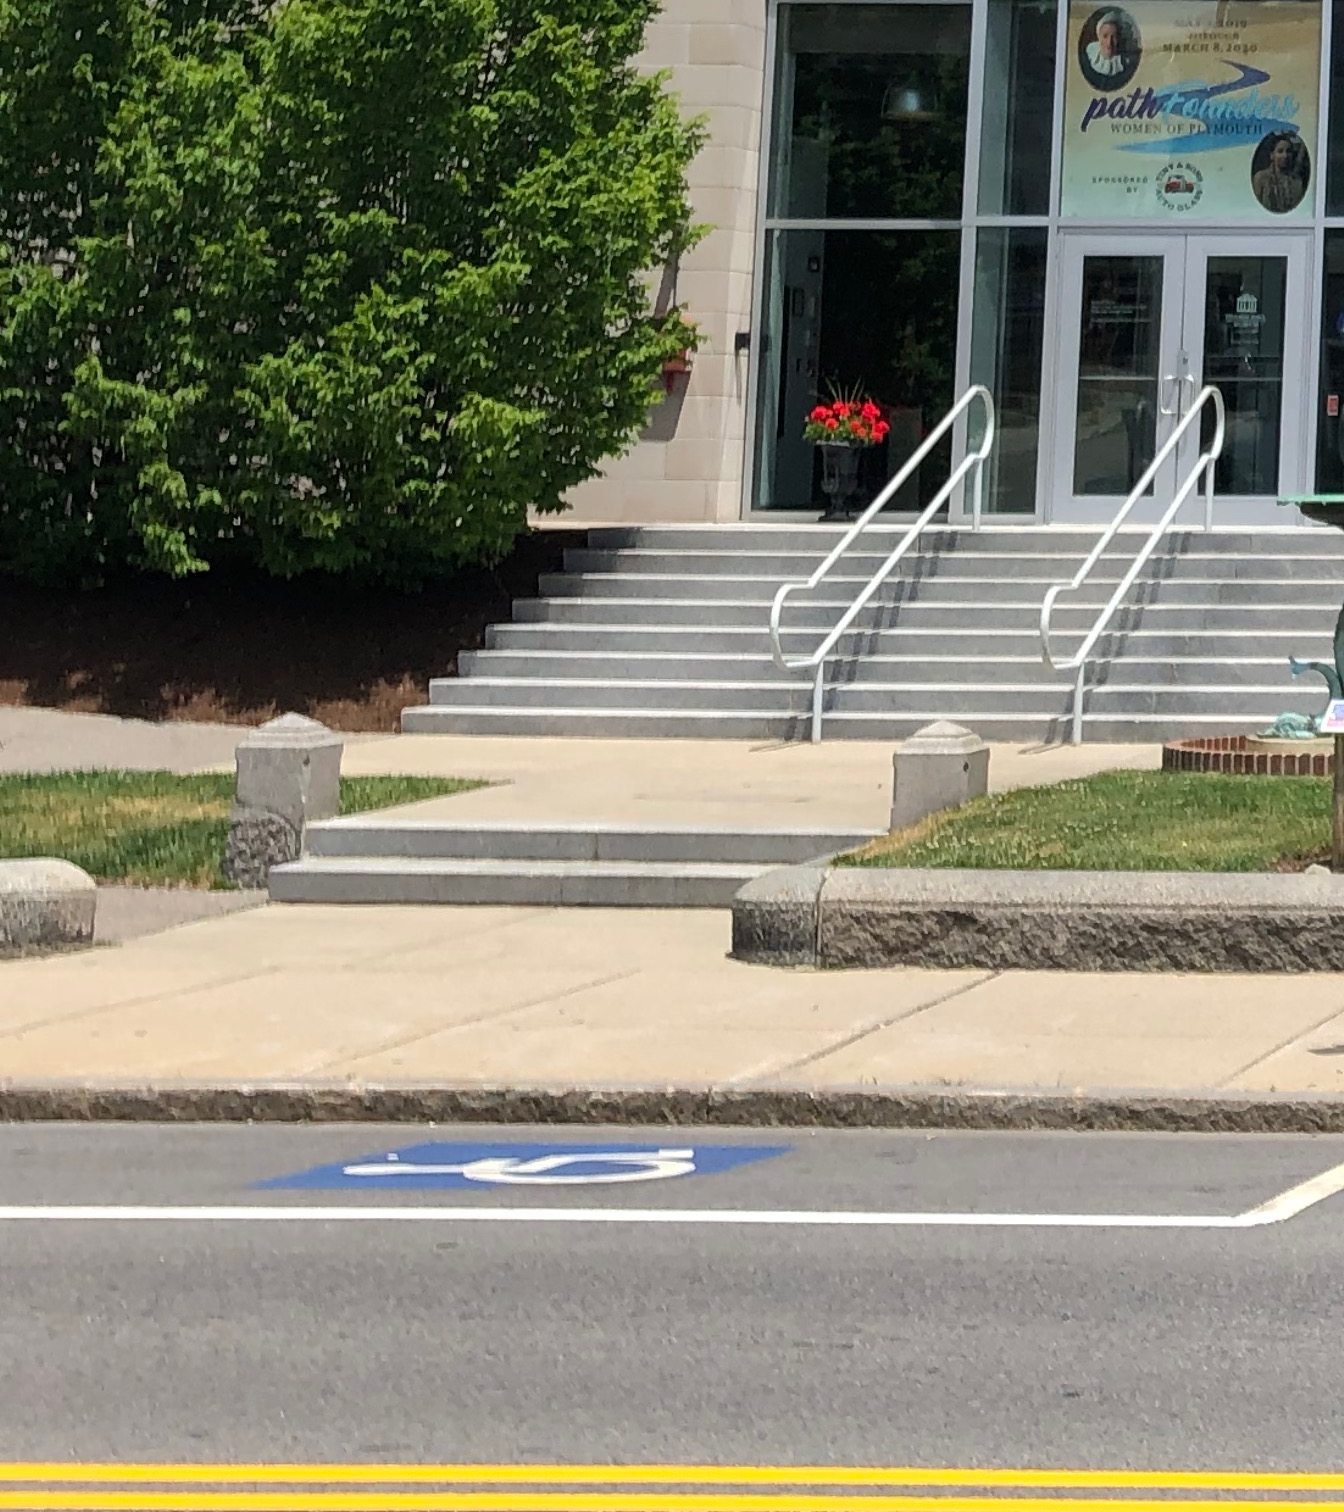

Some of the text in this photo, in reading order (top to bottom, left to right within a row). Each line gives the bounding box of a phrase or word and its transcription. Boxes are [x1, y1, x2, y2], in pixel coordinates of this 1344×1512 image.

[1110, 123, 1263, 135] WOMEN OF PLYMOUTH
